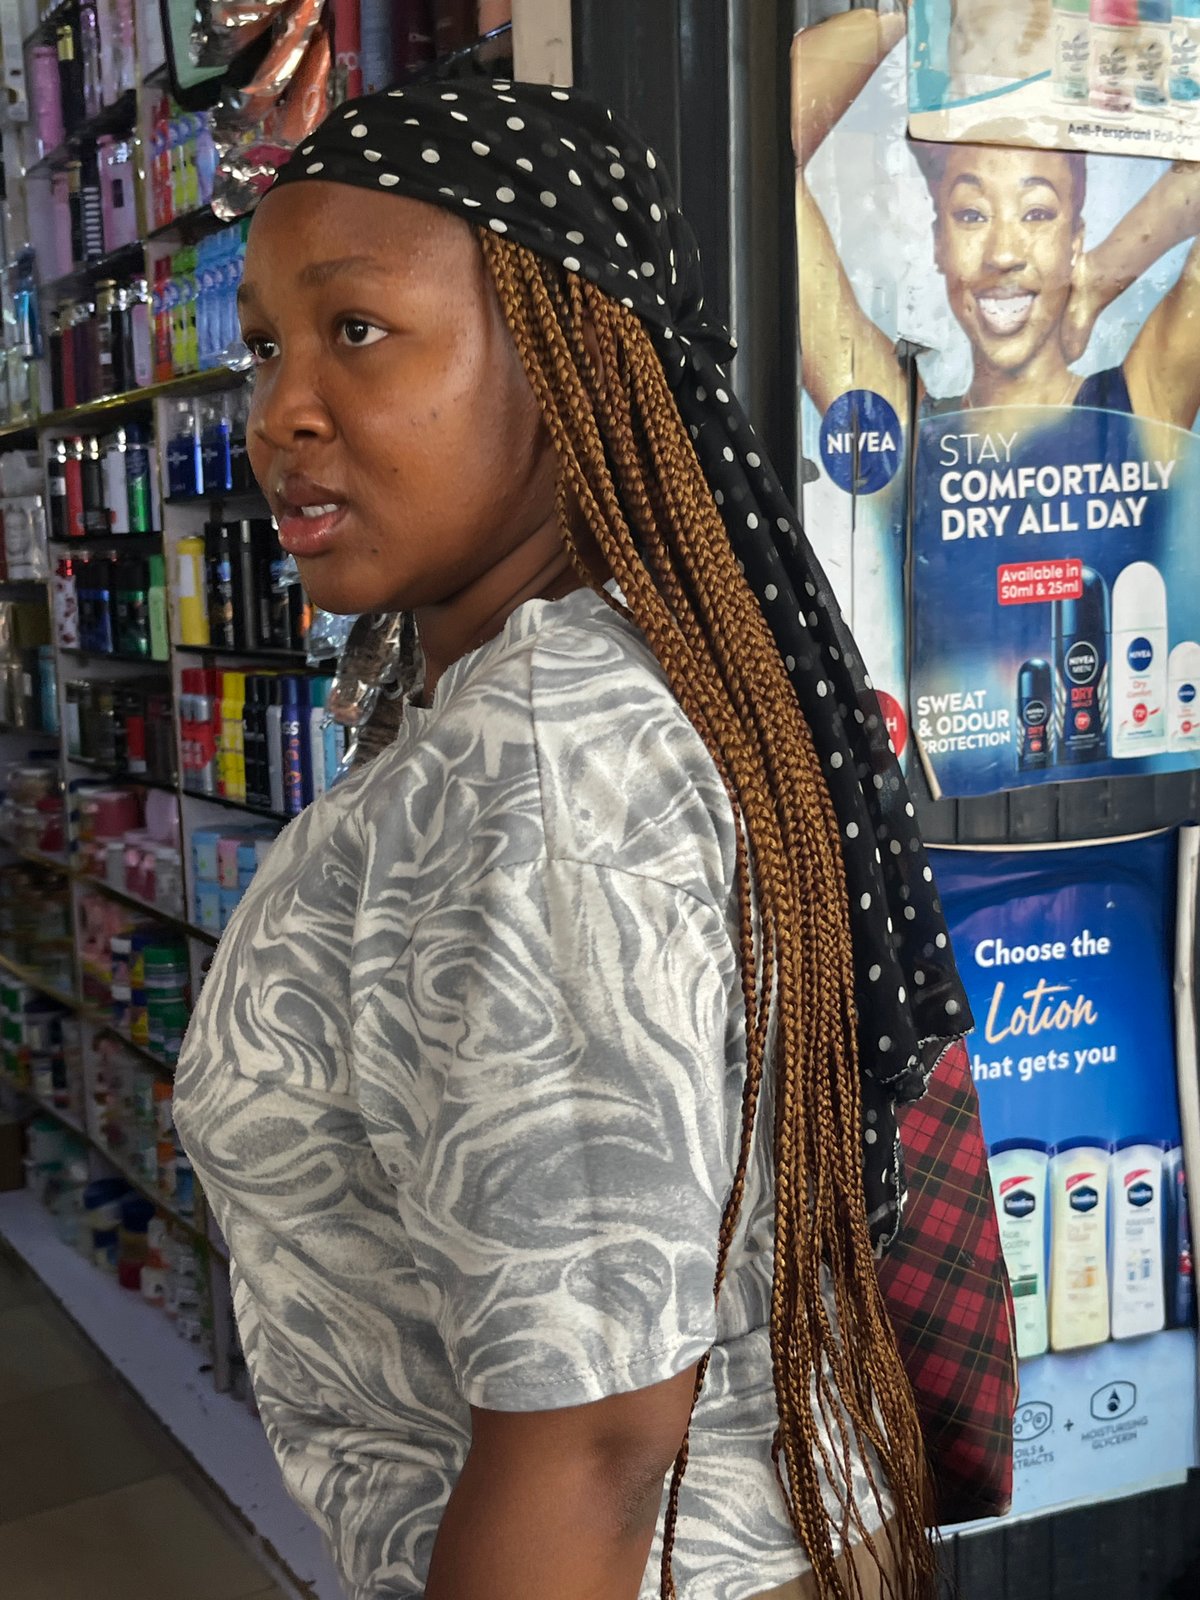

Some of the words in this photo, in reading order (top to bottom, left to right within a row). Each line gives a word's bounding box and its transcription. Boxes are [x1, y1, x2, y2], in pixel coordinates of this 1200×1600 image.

[827, 431, 896, 454] NIVEA
[939, 432, 1018, 466] STAY
[939, 460, 1176, 504] COMFORTABLY
[942, 505, 1011, 541] DRY
[1018, 502, 1079, 535] ALL
[1087, 496, 1148, 530] DAY
[1001, 565, 1063, 583] Available
[1066, 563, 1079, 577] in
[1001, 584, 1033, 599] 50ml
[1036, 583, 1045, 596] &
[1048, 580, 1079, 595] 25ml
[1069, 655, 1095, 665] NIVEA
[917, 690, 986, 716] SWEAT
[1071, 686, 1094, 700] DRY
[918, 717, 933, 737] &
[936, 709, 1010, 735] ODOUR
[974, 938, 1066, 968] Choose
[1071, 929, 1111, 957] the
[985, 978, 1098, 1044] Lotion
[970, 1054, 1013, 1080] hat
[1018, 1049, 1069, 1081] gets
[1074, 1045, 1117, 1074] you
[1081, 1415, 1149, 1440] MOISTURISING
[1014, 1445, 1037, 1459] OILS
[1092, 1431, 1138, 1450] GLYCERIN
